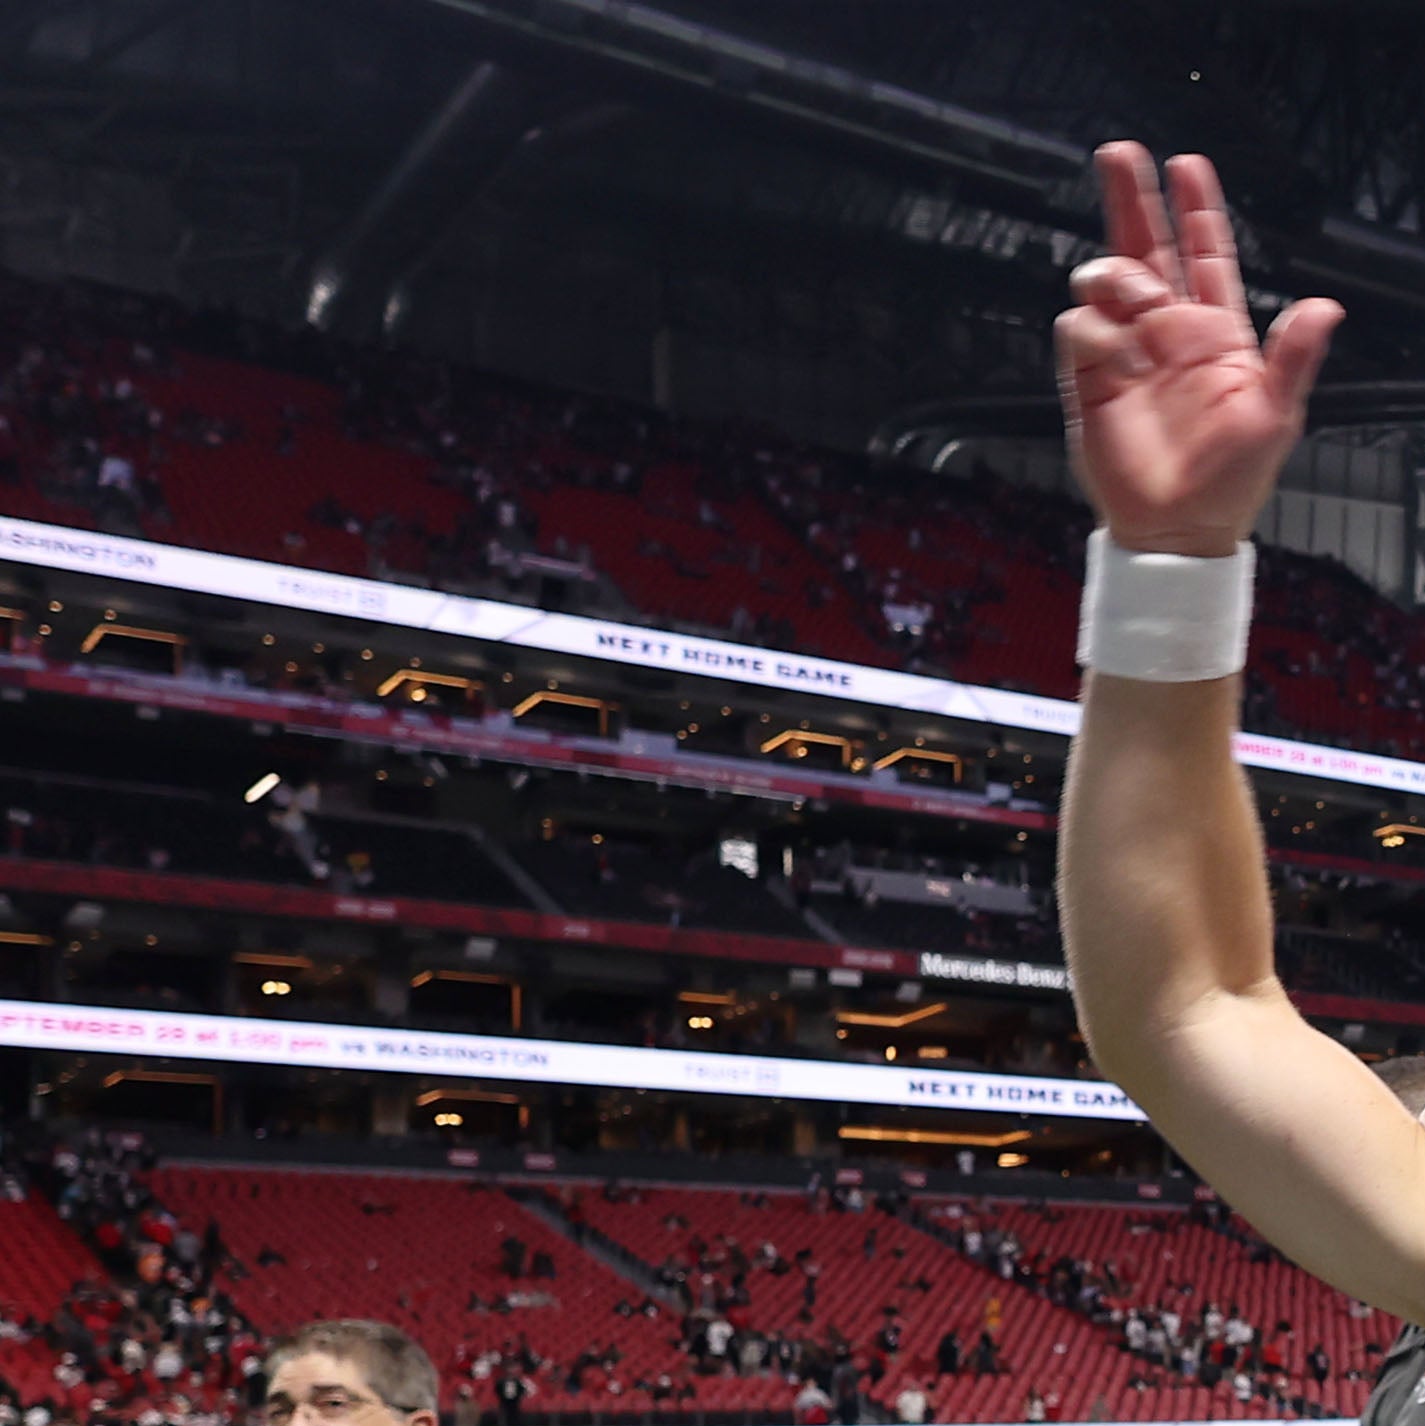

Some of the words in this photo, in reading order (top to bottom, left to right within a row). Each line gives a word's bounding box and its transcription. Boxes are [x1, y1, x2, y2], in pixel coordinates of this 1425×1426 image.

[597, 633, 669, 657] NEXT
[683, 649, 766, 673] HOME
[776, 663, 852, 687] GAME
[908, 1080, 975, 1097] NEXT
[987, 1085, 1064, 1103] HOME
[1073, 1091, 1134, 1108] GAM
